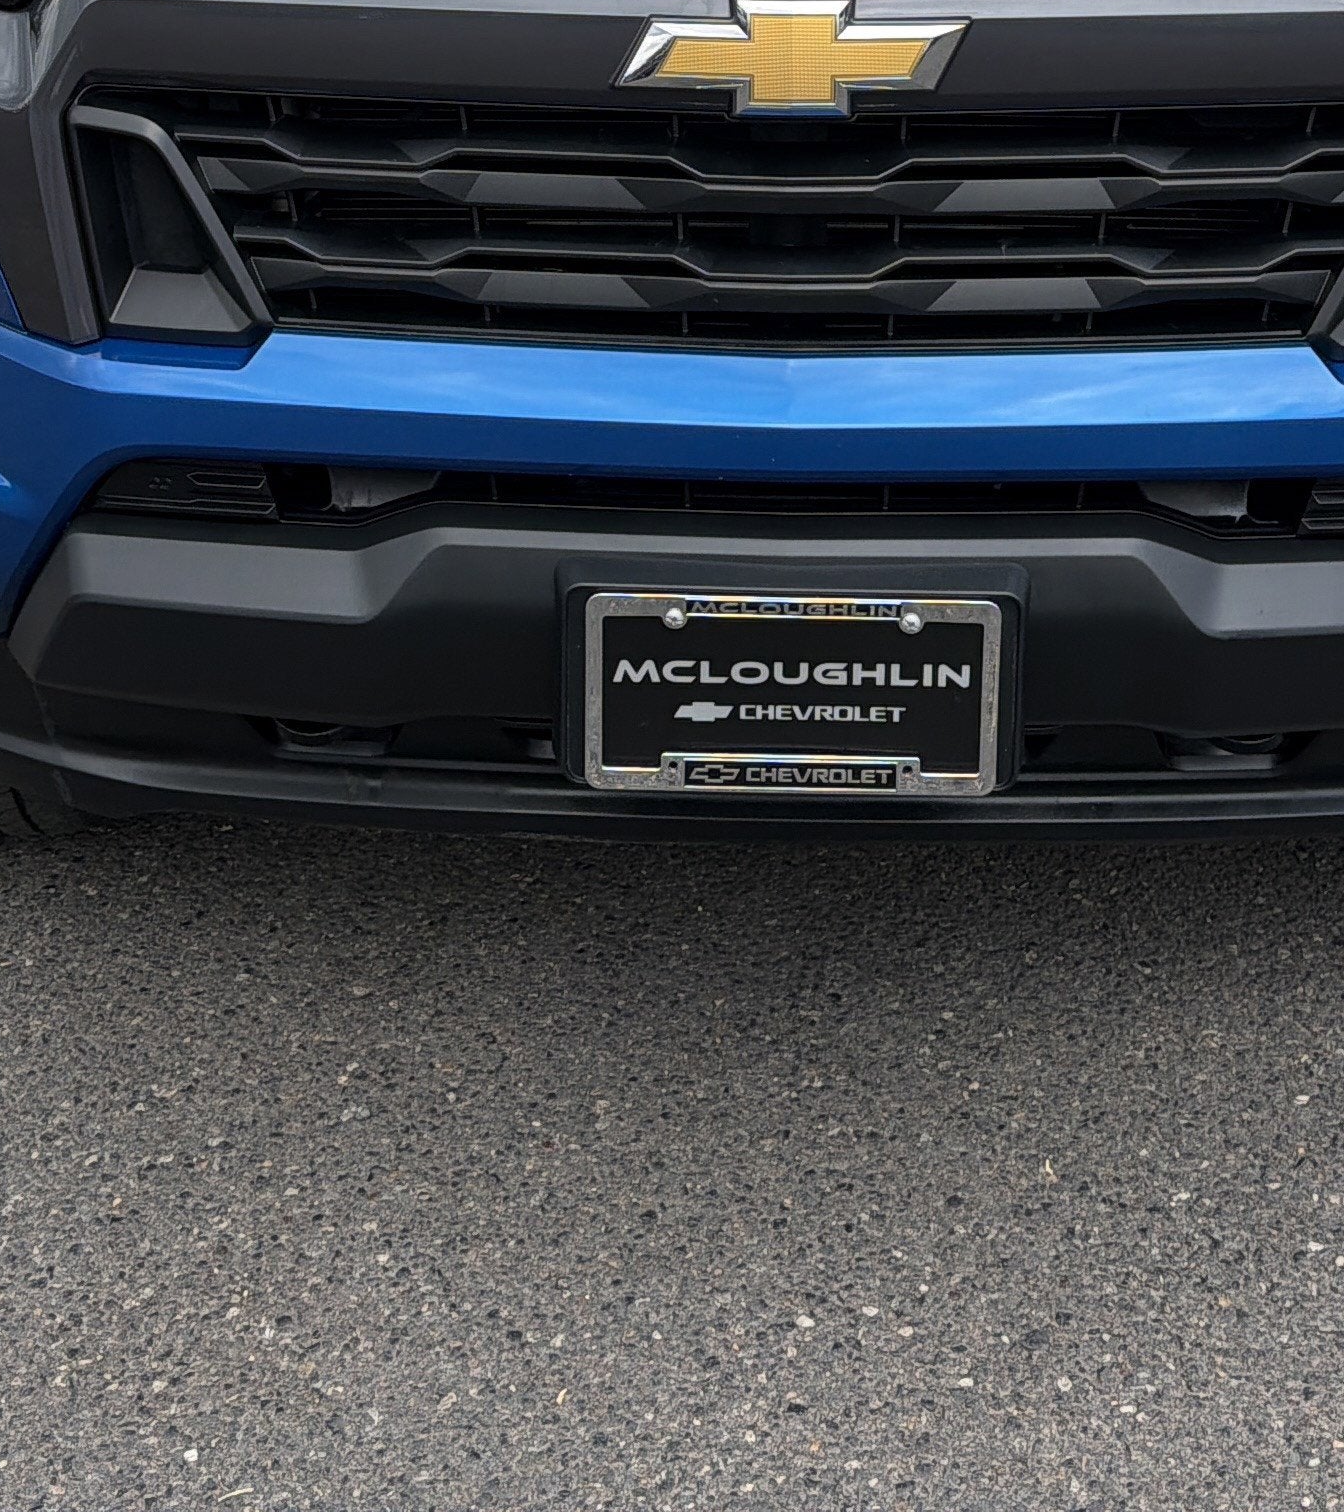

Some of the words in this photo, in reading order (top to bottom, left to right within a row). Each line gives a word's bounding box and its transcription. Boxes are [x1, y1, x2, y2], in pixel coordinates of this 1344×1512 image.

[691, 600, 899, 618] MCLOUGHLIN
[612, 659, 971, 689] MCLOUGHLIN
[739, 704, 906, 723] CHEVROLET
[745, 767, 893, 784] CHEVROLET
